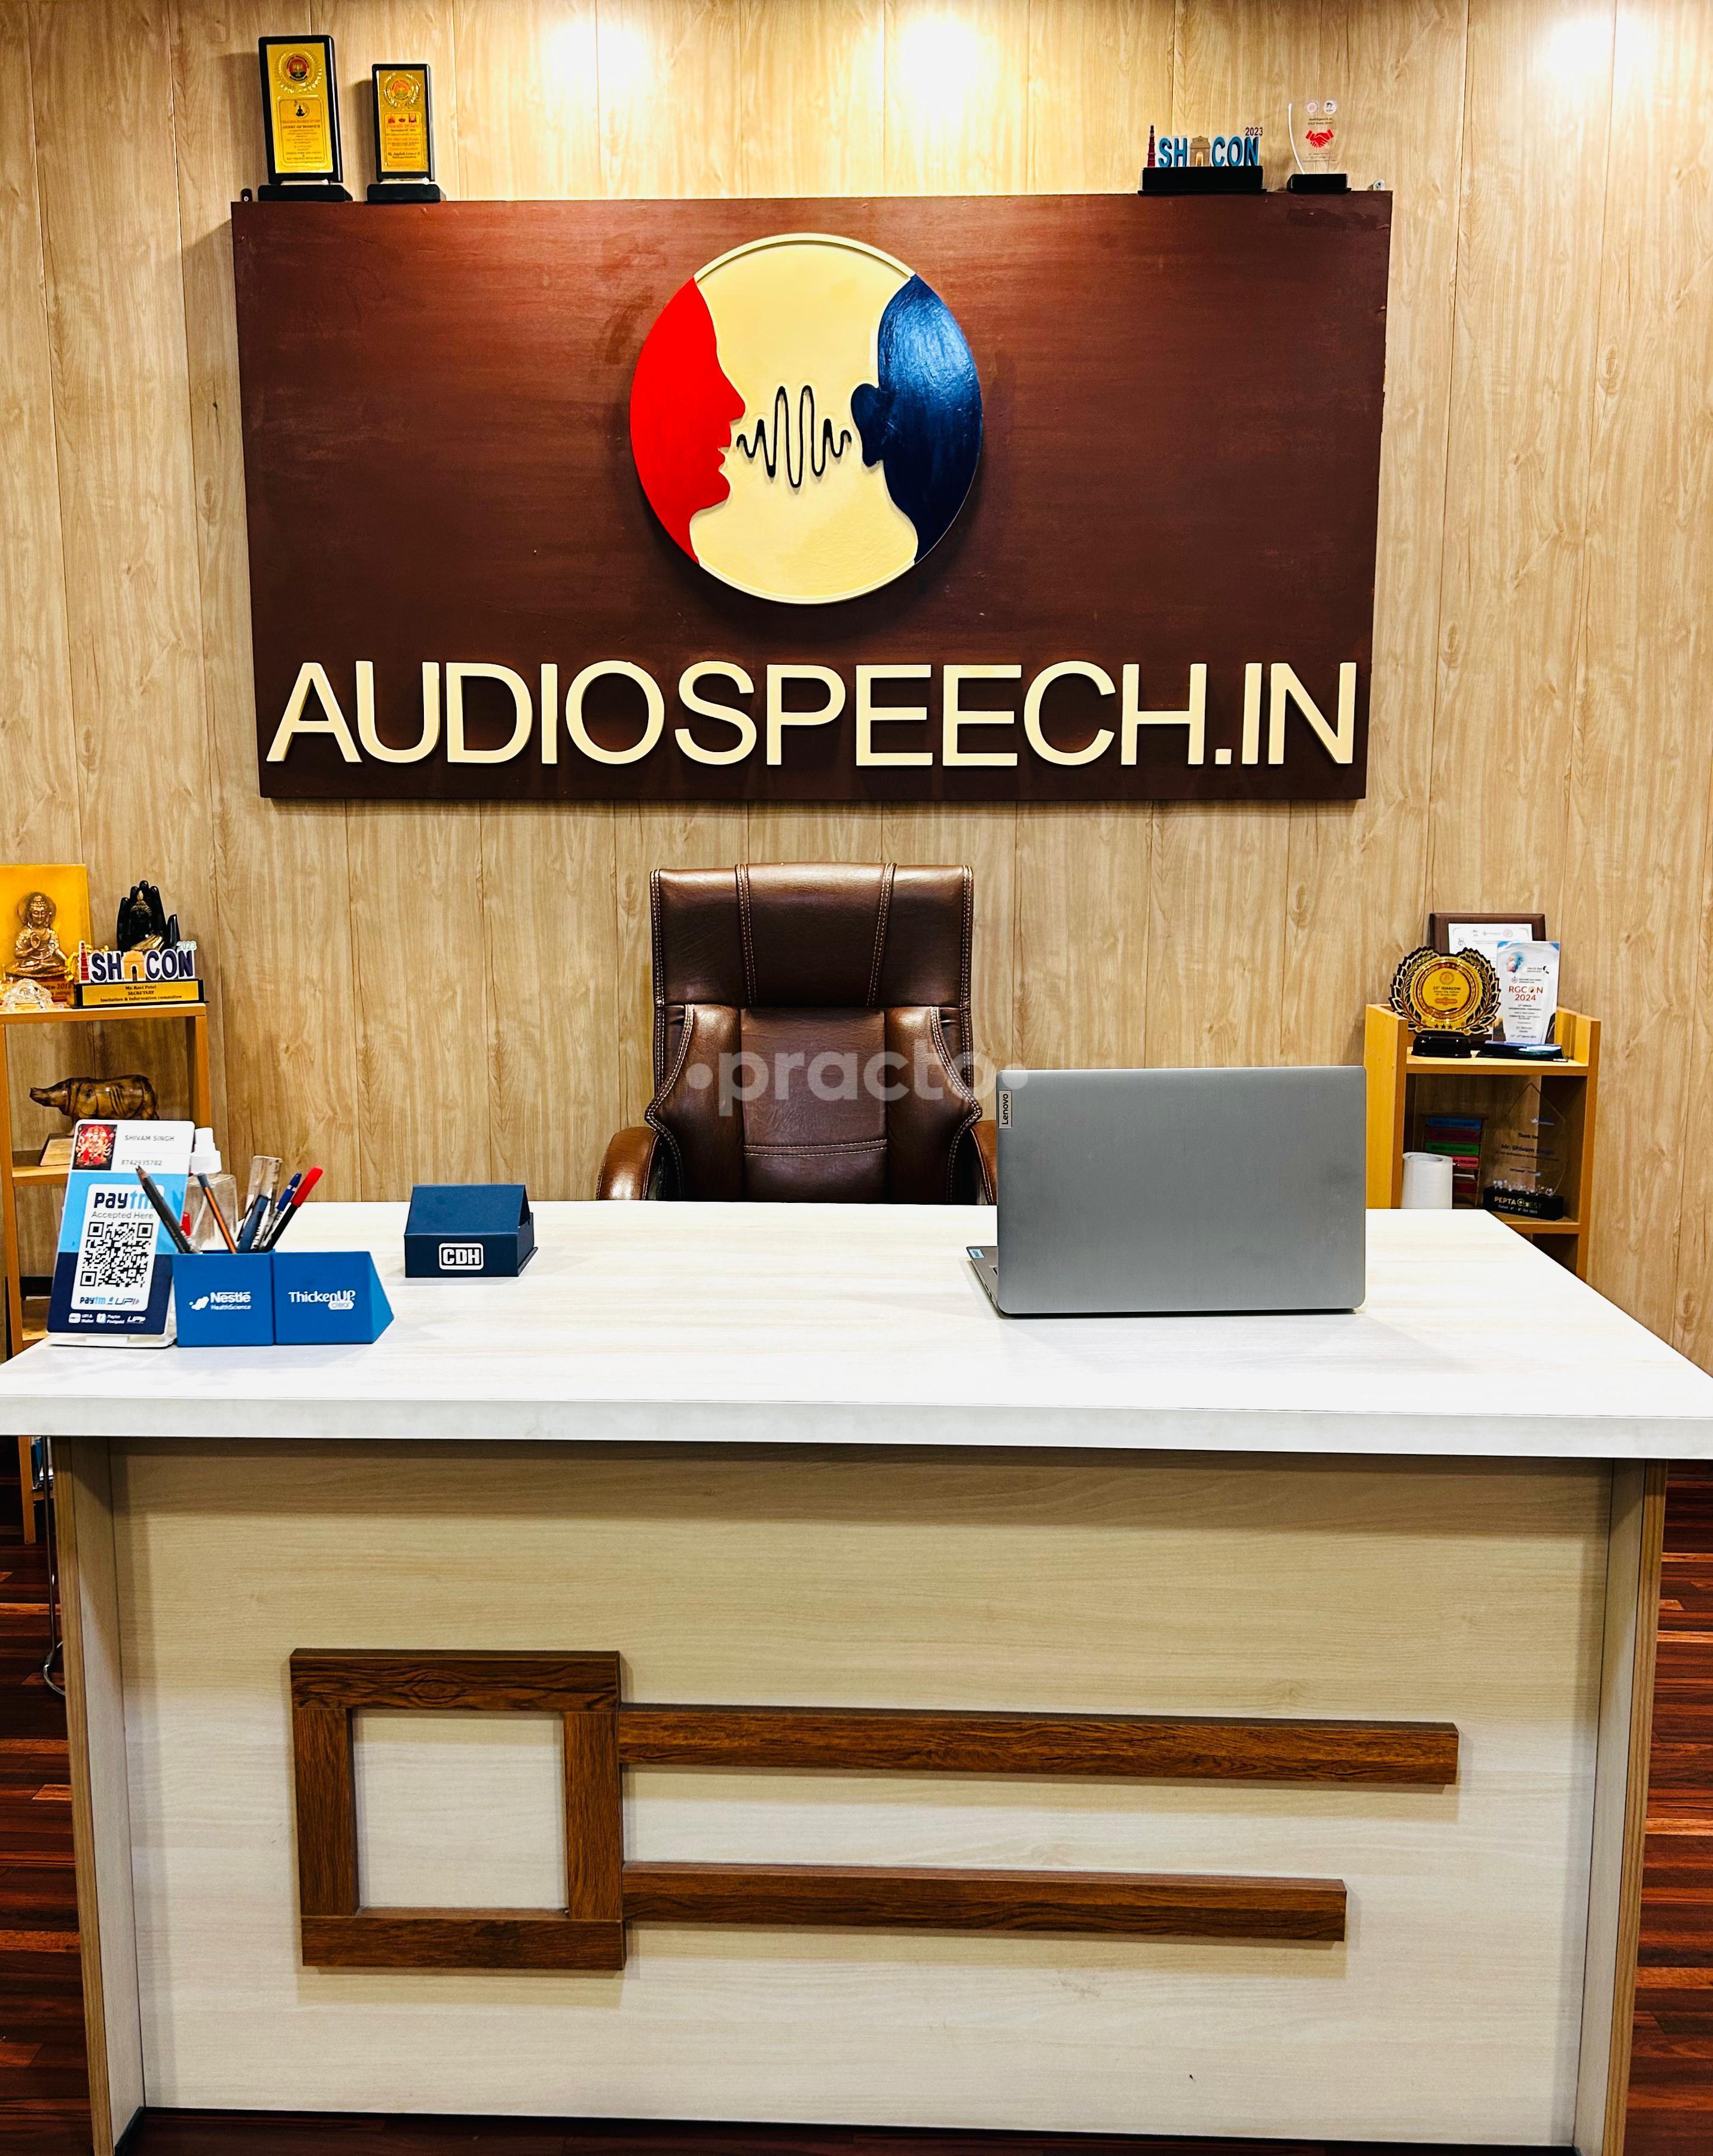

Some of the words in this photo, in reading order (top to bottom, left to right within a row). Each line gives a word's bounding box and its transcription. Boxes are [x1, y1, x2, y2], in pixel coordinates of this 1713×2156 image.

[1245, 127, 1263, 136] 2023
[267, 661, 1357, 766] AUDIOSPEECH.IN
[178, 941, 196, 949] 2023
[91, 1211, 132, 1219] Accepted
[442, 1248, 480, 1265] CDH
